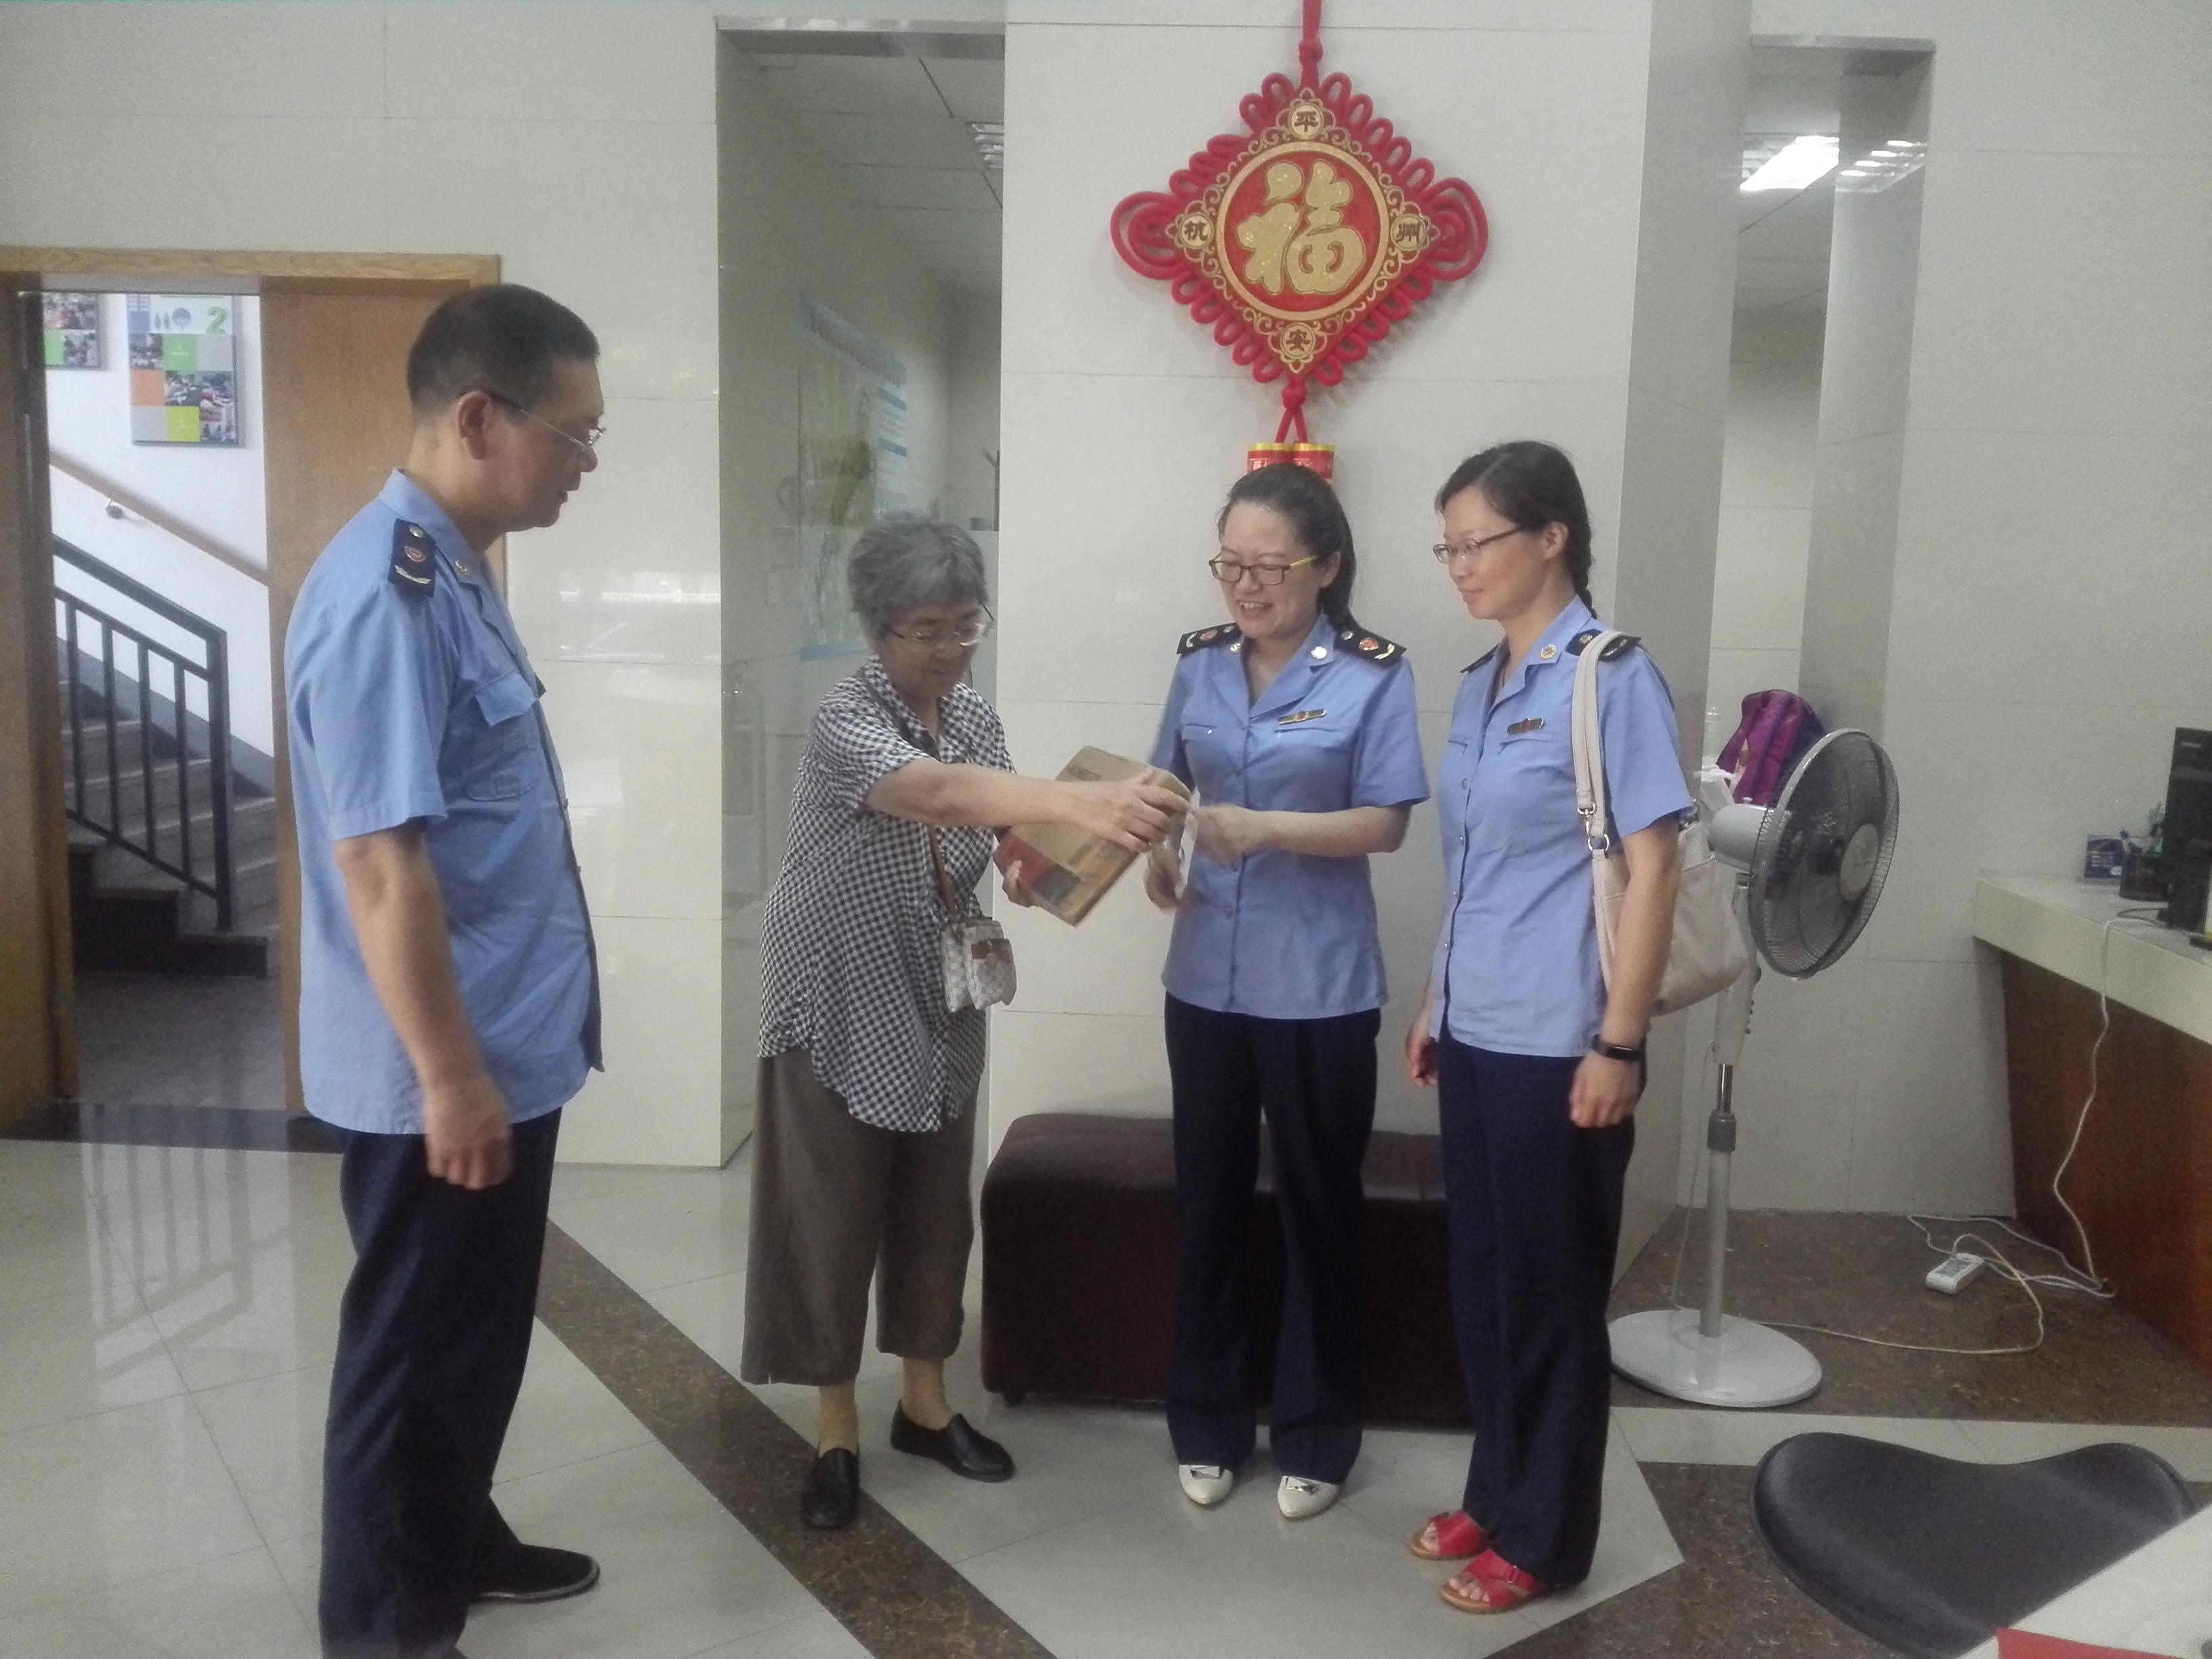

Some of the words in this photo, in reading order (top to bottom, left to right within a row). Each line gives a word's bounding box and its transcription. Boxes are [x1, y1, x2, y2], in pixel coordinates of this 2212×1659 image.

[1294, 111, 1319, 131] 平
[1237, 161, 1366, 295] 福
[1395, 220, 1420, 243] 州
[206, 306, 227, 334] 2
[1286, 329, 1311, 352] 安
